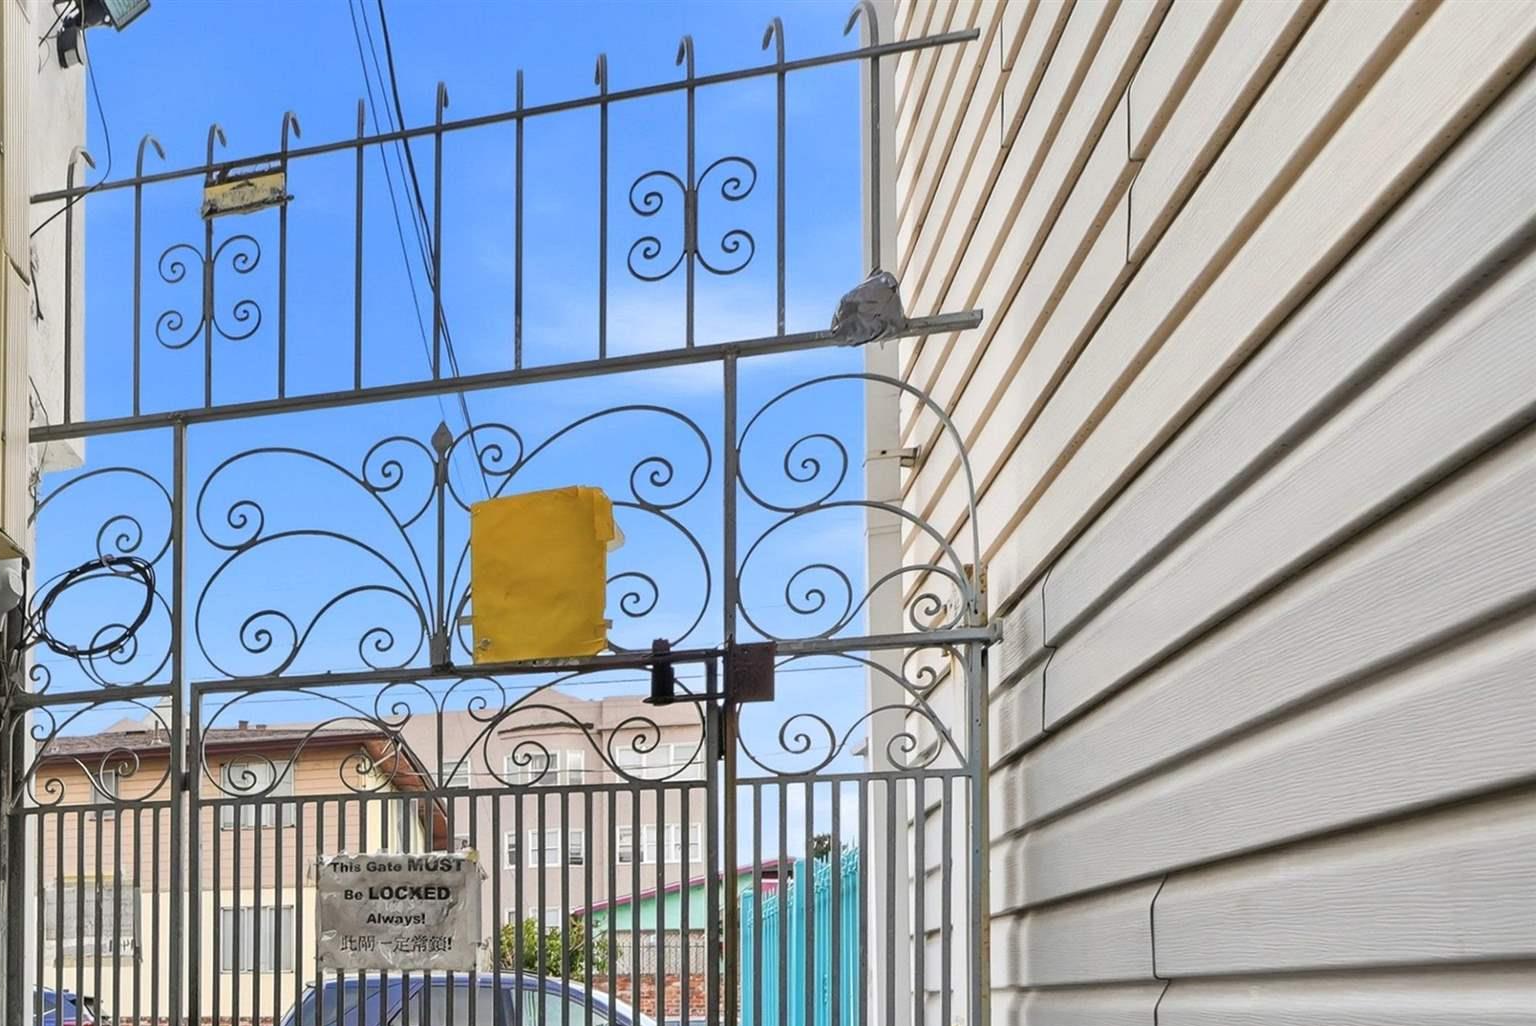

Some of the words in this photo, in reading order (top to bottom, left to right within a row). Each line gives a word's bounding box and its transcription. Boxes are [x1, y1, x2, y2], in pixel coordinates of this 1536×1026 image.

[331, 861, 361, 873] This
[366, 860, 402, 873] Gate
[407, 857, 465, 873] MUST
[344, 889, 363, 901] Be
[368, 886, 451, 901] LOCKED
[366, 912, 426, 926] Always!
